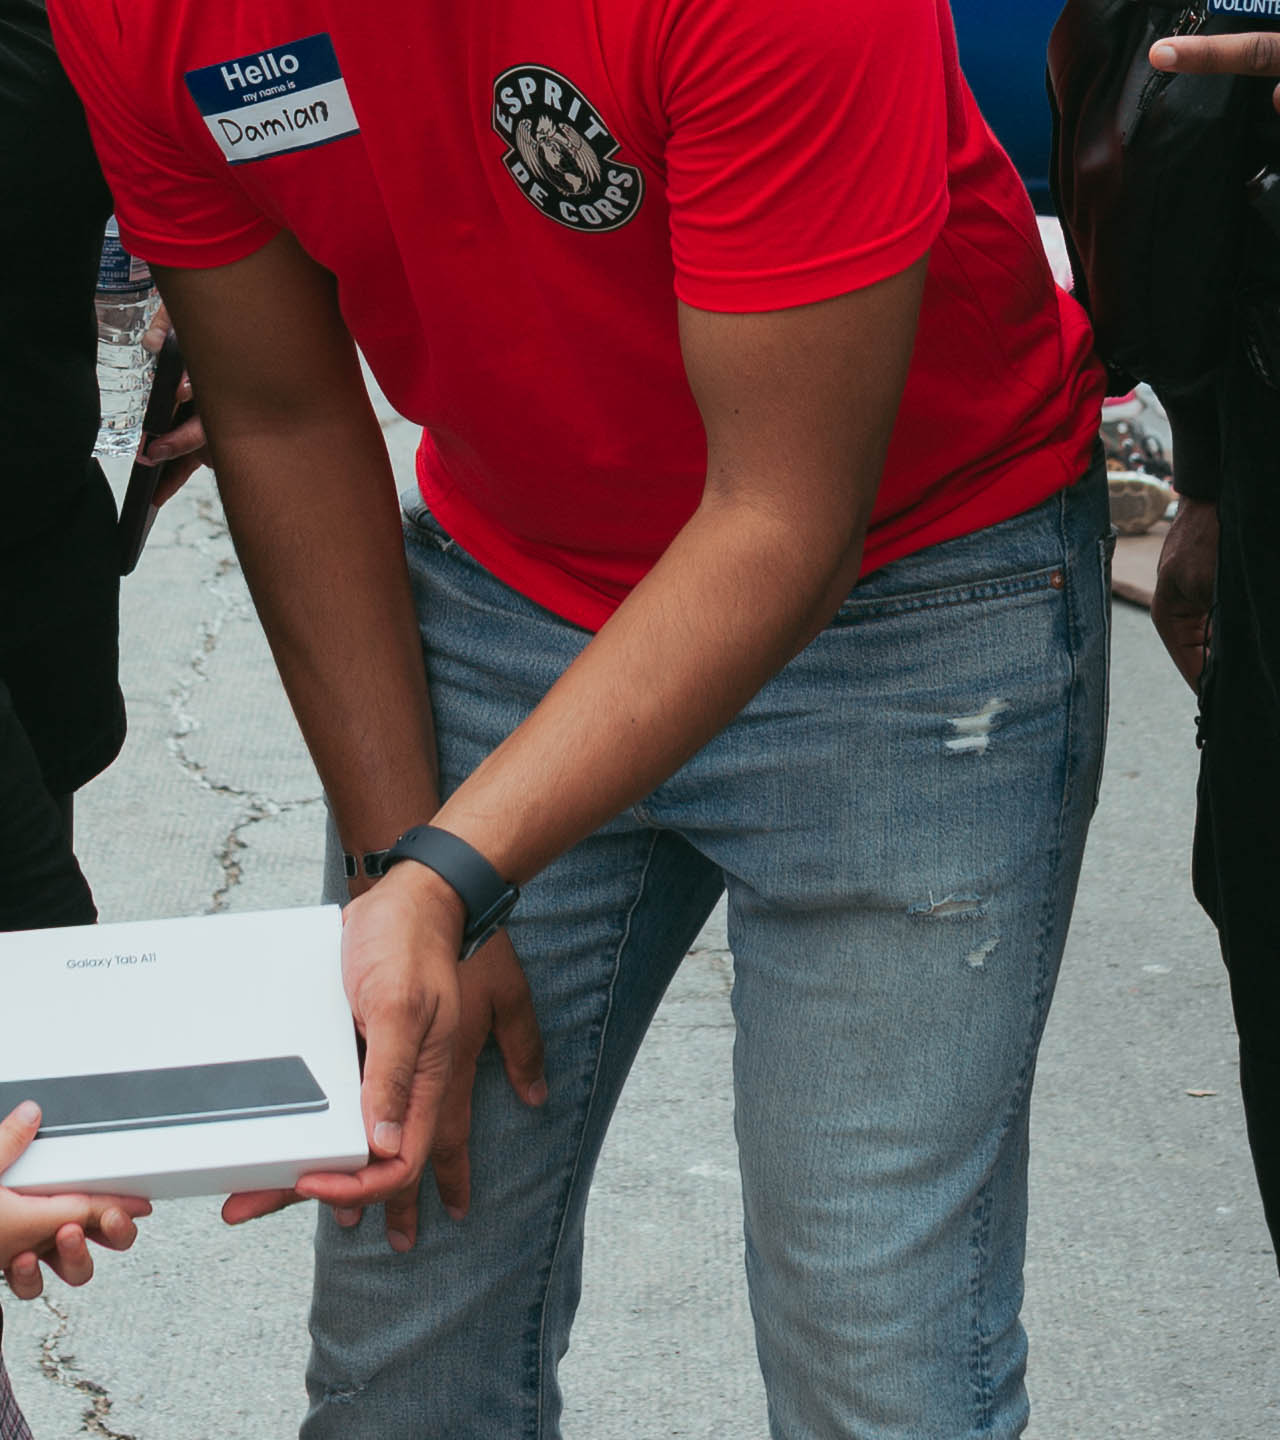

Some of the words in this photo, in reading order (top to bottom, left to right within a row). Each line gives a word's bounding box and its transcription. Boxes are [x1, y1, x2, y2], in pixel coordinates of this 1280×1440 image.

[220, 52, 300, 92] Hello
[242, 91, 259, 103] my
[258, 84, 287, 99] name
[287, 79, 296, 90] is
[218, 99, 329, 146] Damian
[496, 76, 608, 141] ESPRIT
[511, 161, 549, 207] DE
[559, 169, 634, 225] CORPS
[66, 956, 113, 969] Galaxy
[114, 954, 138, 966] Tab
[140, 951, 157, 964] A11
